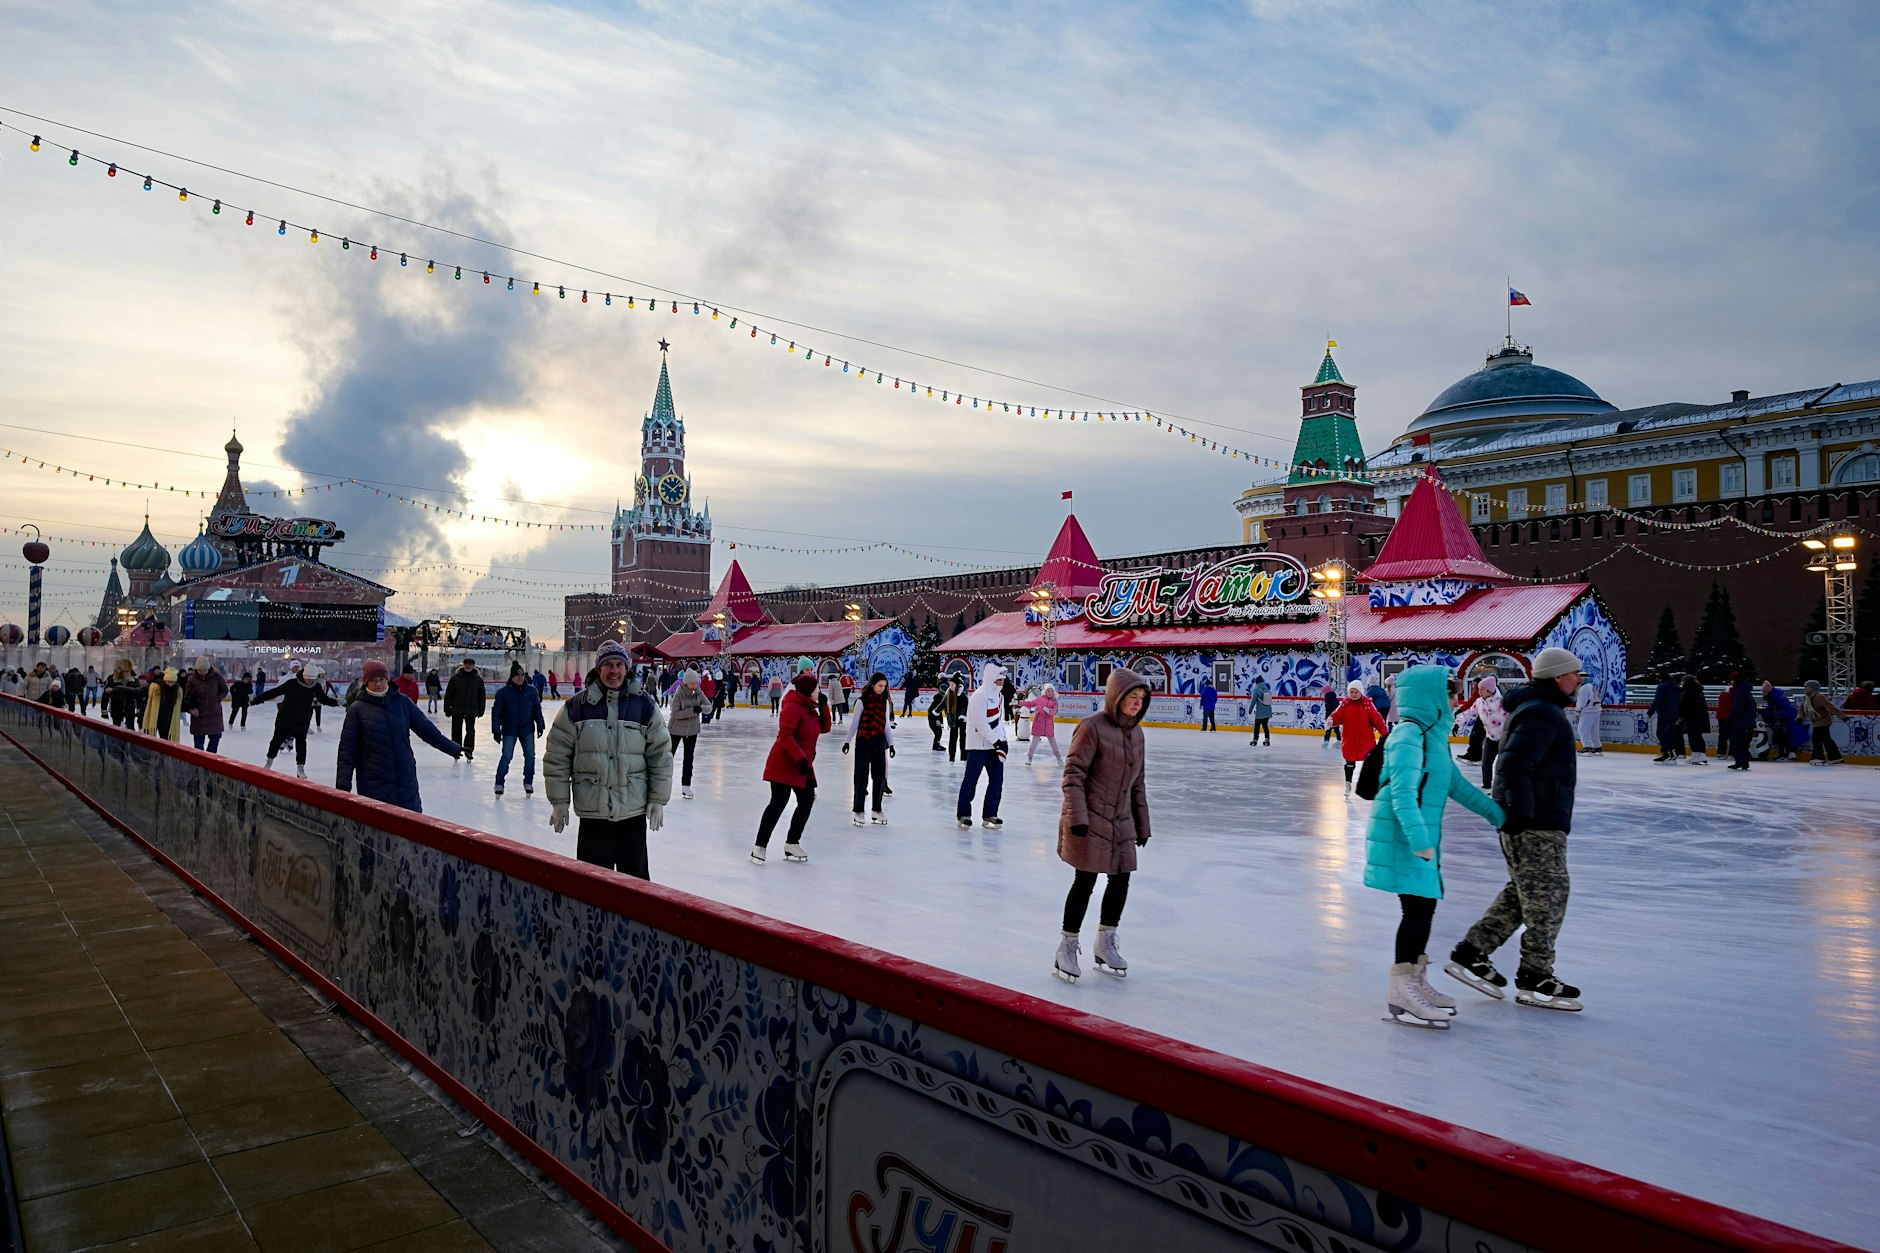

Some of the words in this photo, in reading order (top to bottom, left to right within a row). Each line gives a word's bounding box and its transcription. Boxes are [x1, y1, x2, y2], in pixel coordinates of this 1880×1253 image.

[1229, 606, 1241, 616] на
[254, 645, 291, 654] ПЕРВЫЙ
[292, 646, 321, 654] КАНАЛ
